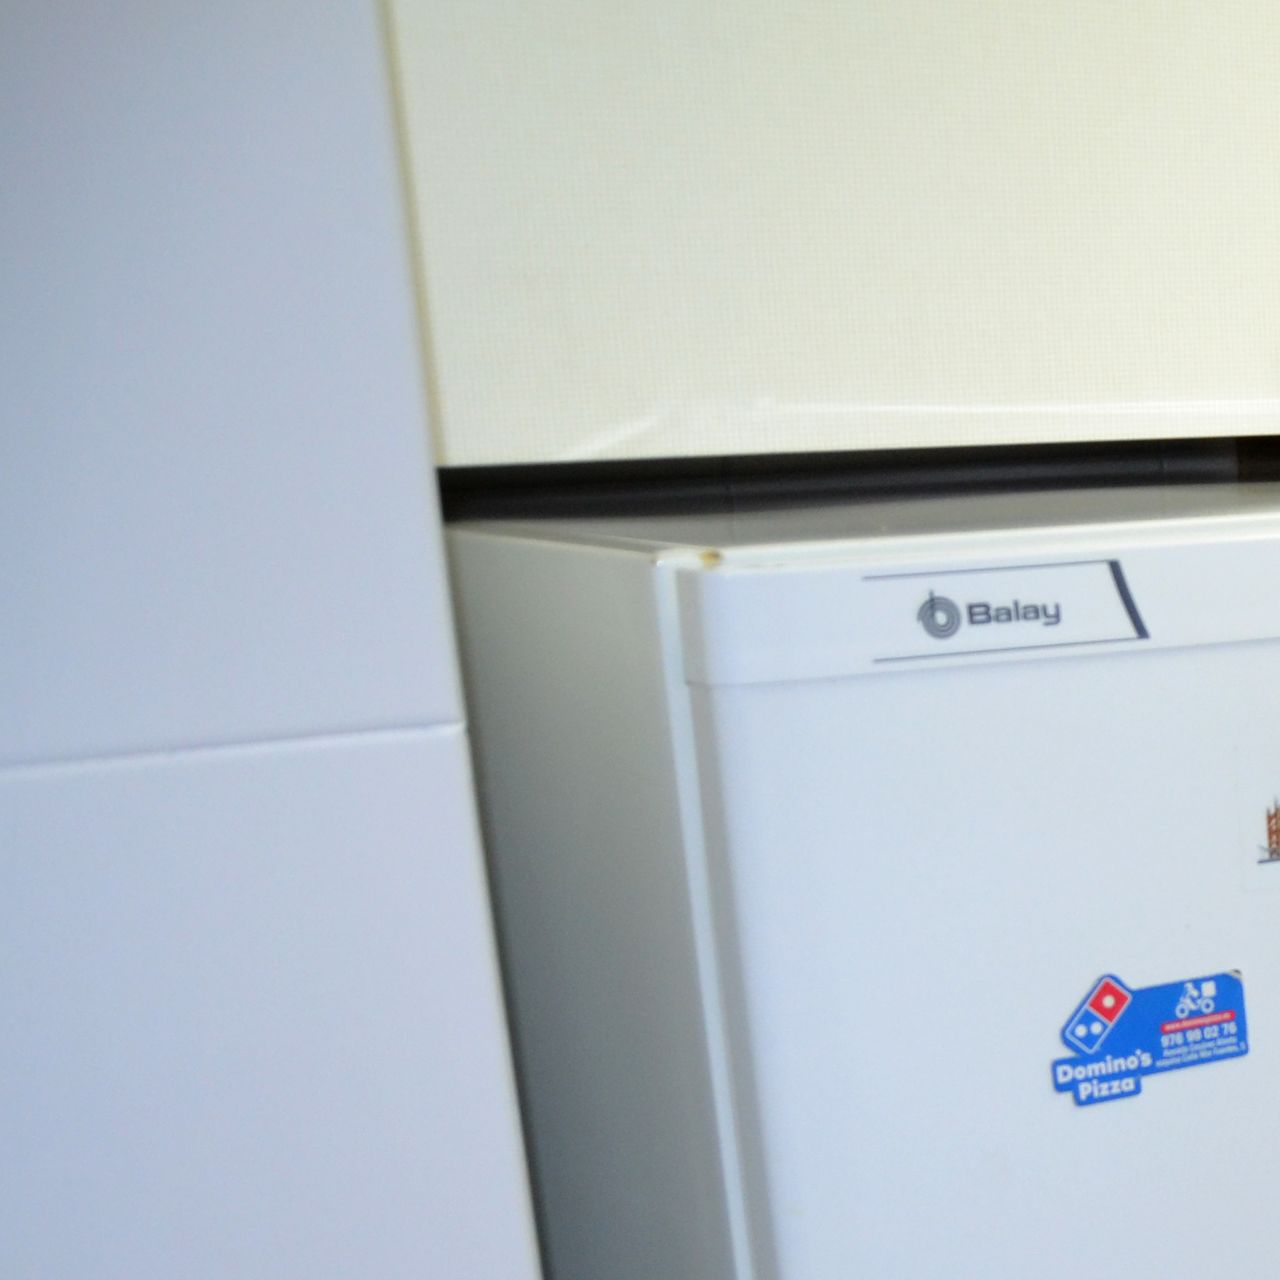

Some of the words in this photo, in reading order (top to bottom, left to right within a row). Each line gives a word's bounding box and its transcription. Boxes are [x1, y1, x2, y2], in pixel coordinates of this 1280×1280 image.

[967, 599, 1061, 626] Balay
[1055, 1048, 1153, 1085] Domino's
[1078, 1077, 1136, 1101] Pizza
